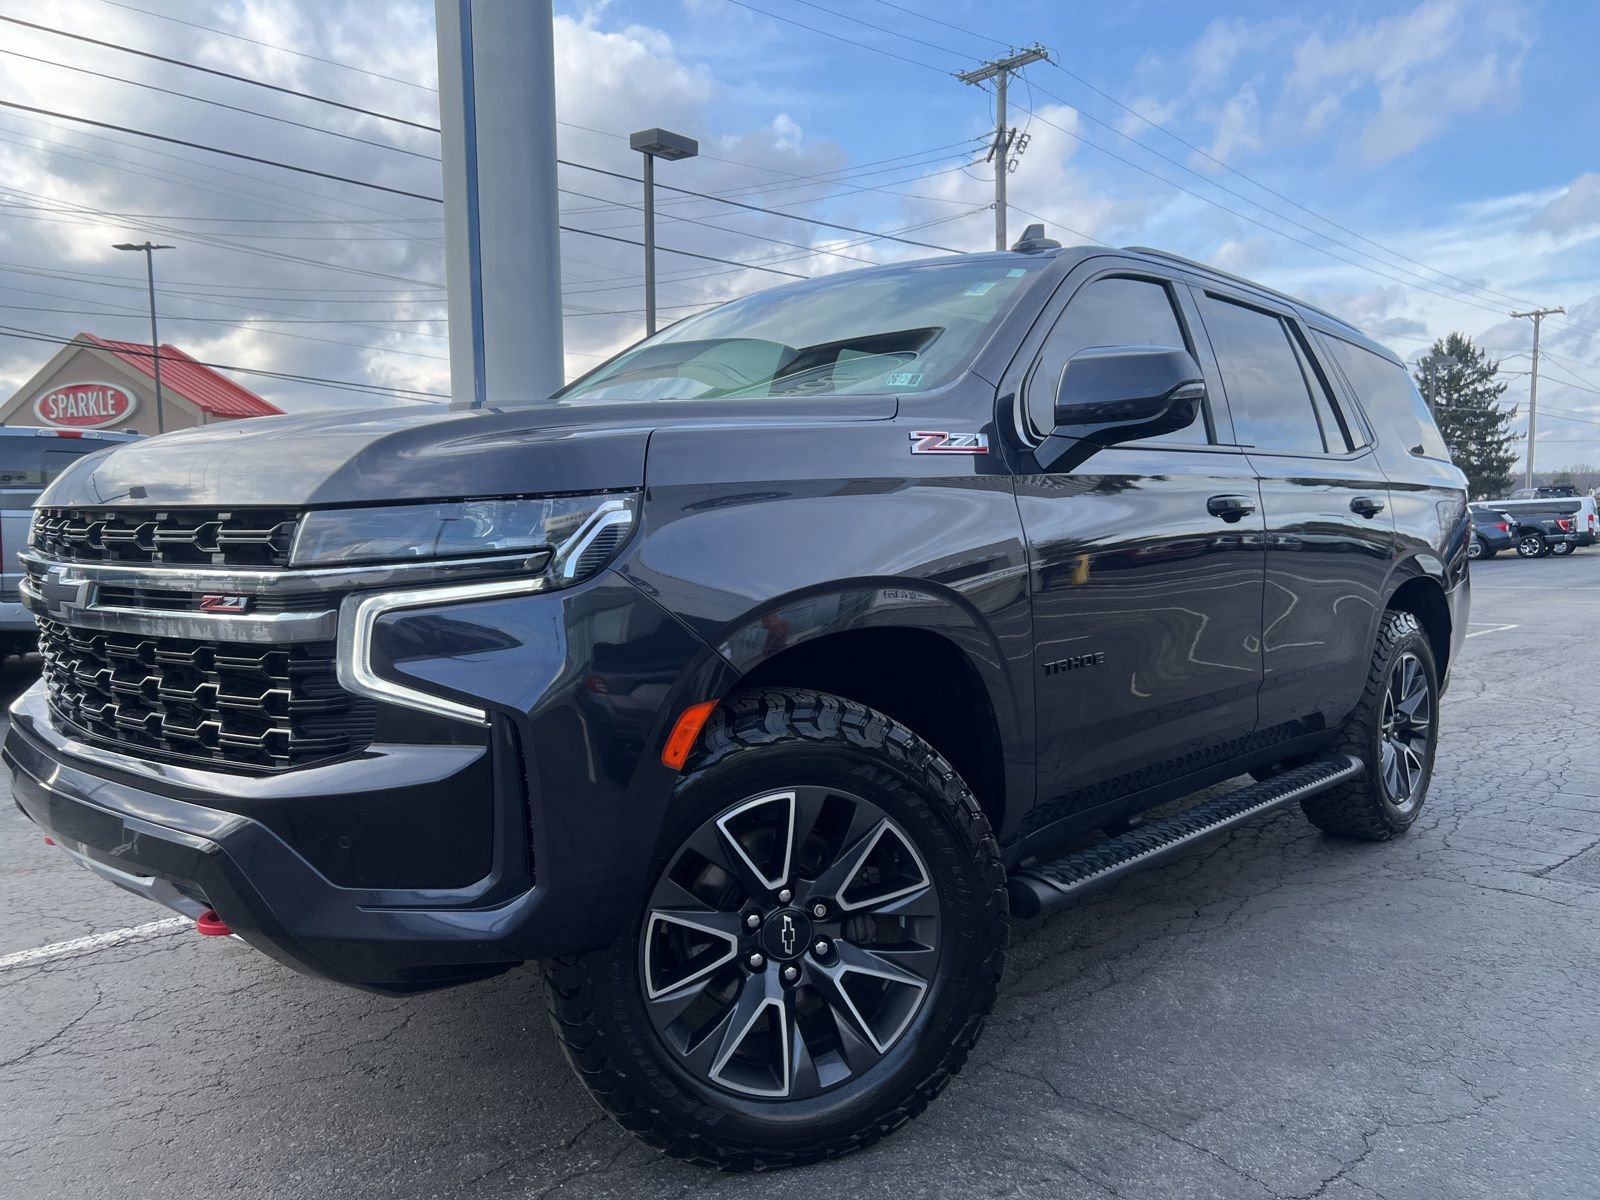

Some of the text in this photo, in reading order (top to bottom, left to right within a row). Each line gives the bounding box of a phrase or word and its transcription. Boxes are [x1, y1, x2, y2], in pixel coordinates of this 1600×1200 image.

[48, 390, 116, 419] SPARKLE
[909, 431, 990, 454] Z71
[200, 595, 248, 612] Z71
[1042, 652, 1105, 676] TAHOE
